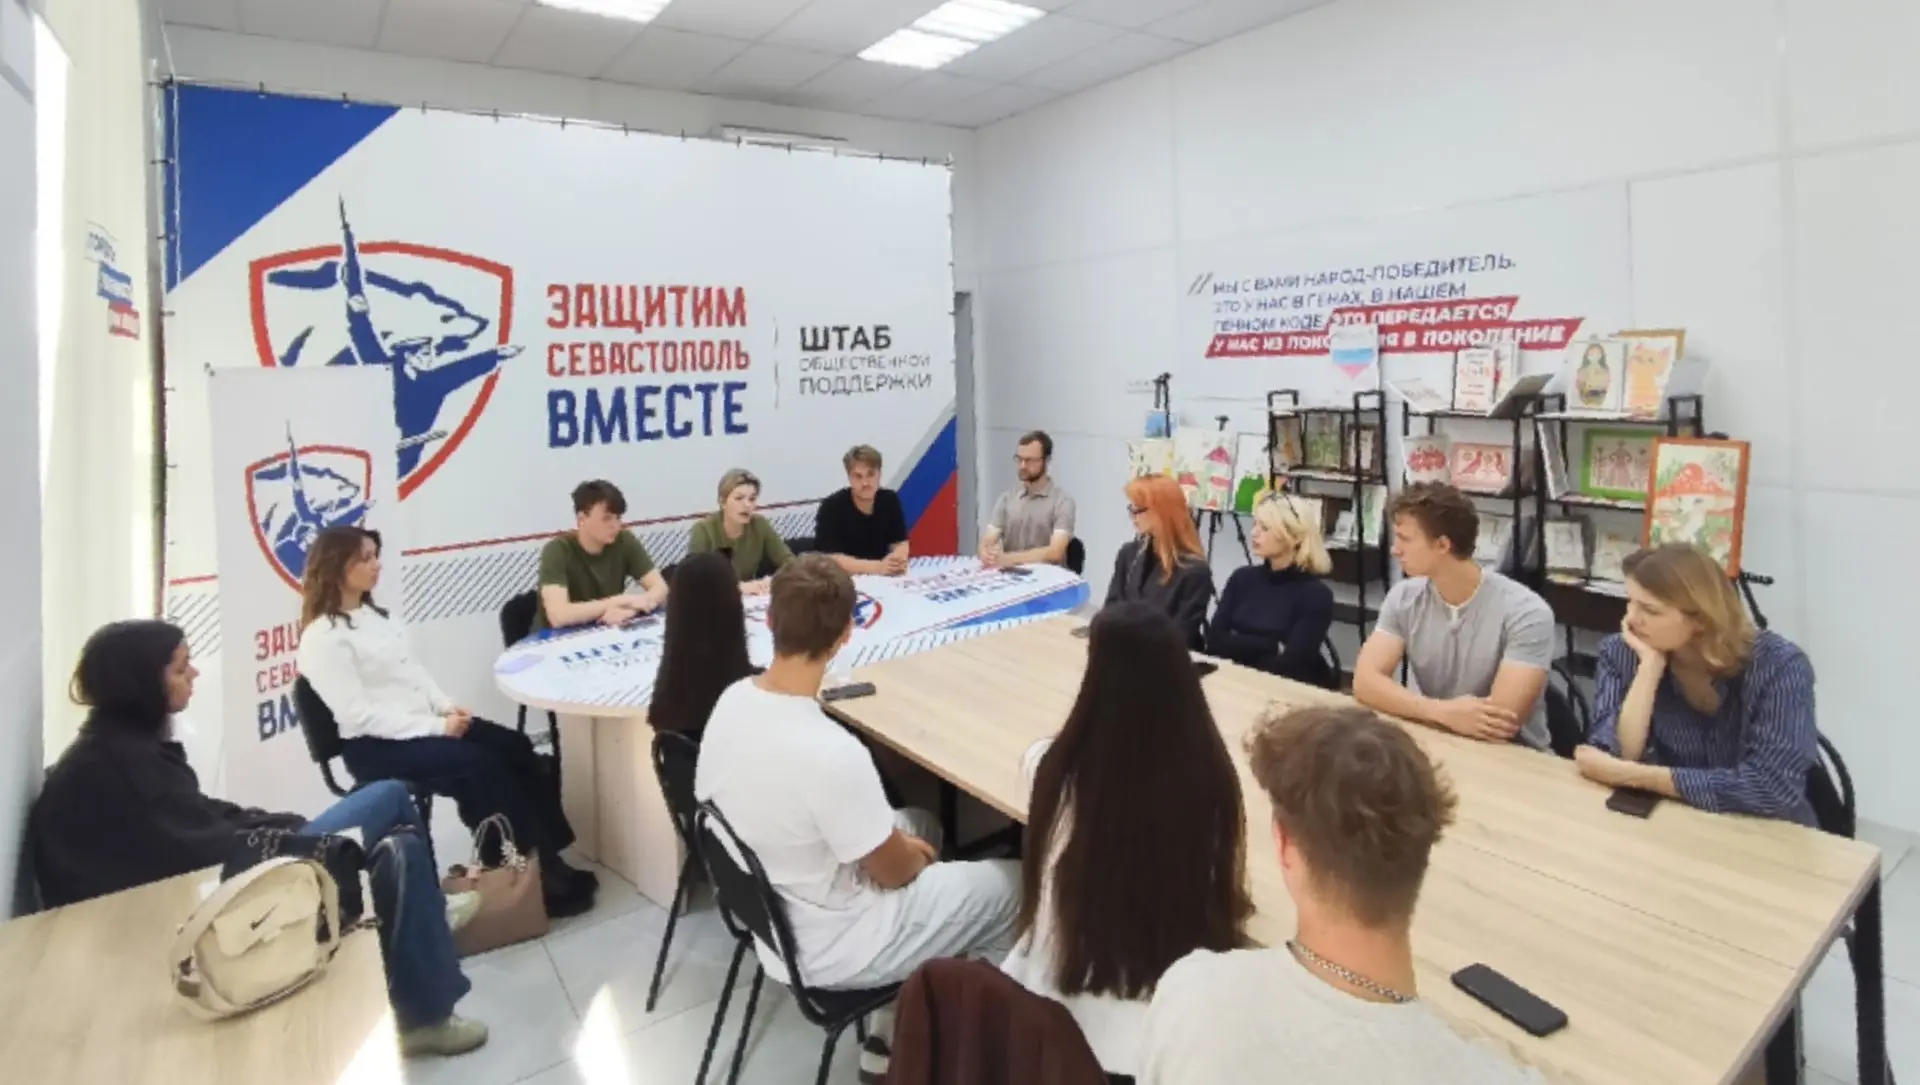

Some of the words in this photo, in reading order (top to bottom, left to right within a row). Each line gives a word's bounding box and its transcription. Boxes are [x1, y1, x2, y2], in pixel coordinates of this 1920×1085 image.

[1254, 274, 1300, 291] ВАМИ
[1256, 297, 1288, 311] НАС
[1292, 294, 1302, 309] В
[1372, 287, 1384, 304] В
[1389, 282, 1466, 301] НАШЕМ
[547, 283, 747, 334] ЗАЩИТИМ
[800, 325, 892, 352] ШТАБ
[1214, 338, 1225, 352] У
[1227, 337, 1261, 351] НАС
[1262, 337, 1284, 351] ИЗ
[1403, 331, 1417, 347] В
[1421, 325, 1566, 346] ПОКОЛЕНИЕ
[547, 339, 750, 378] СЕВАСТОПОЛЬ
[800, 374, 933, 397] ПОДДЕРЖКИ
[547, 381, 749, 448] ВМЕСТЕ
